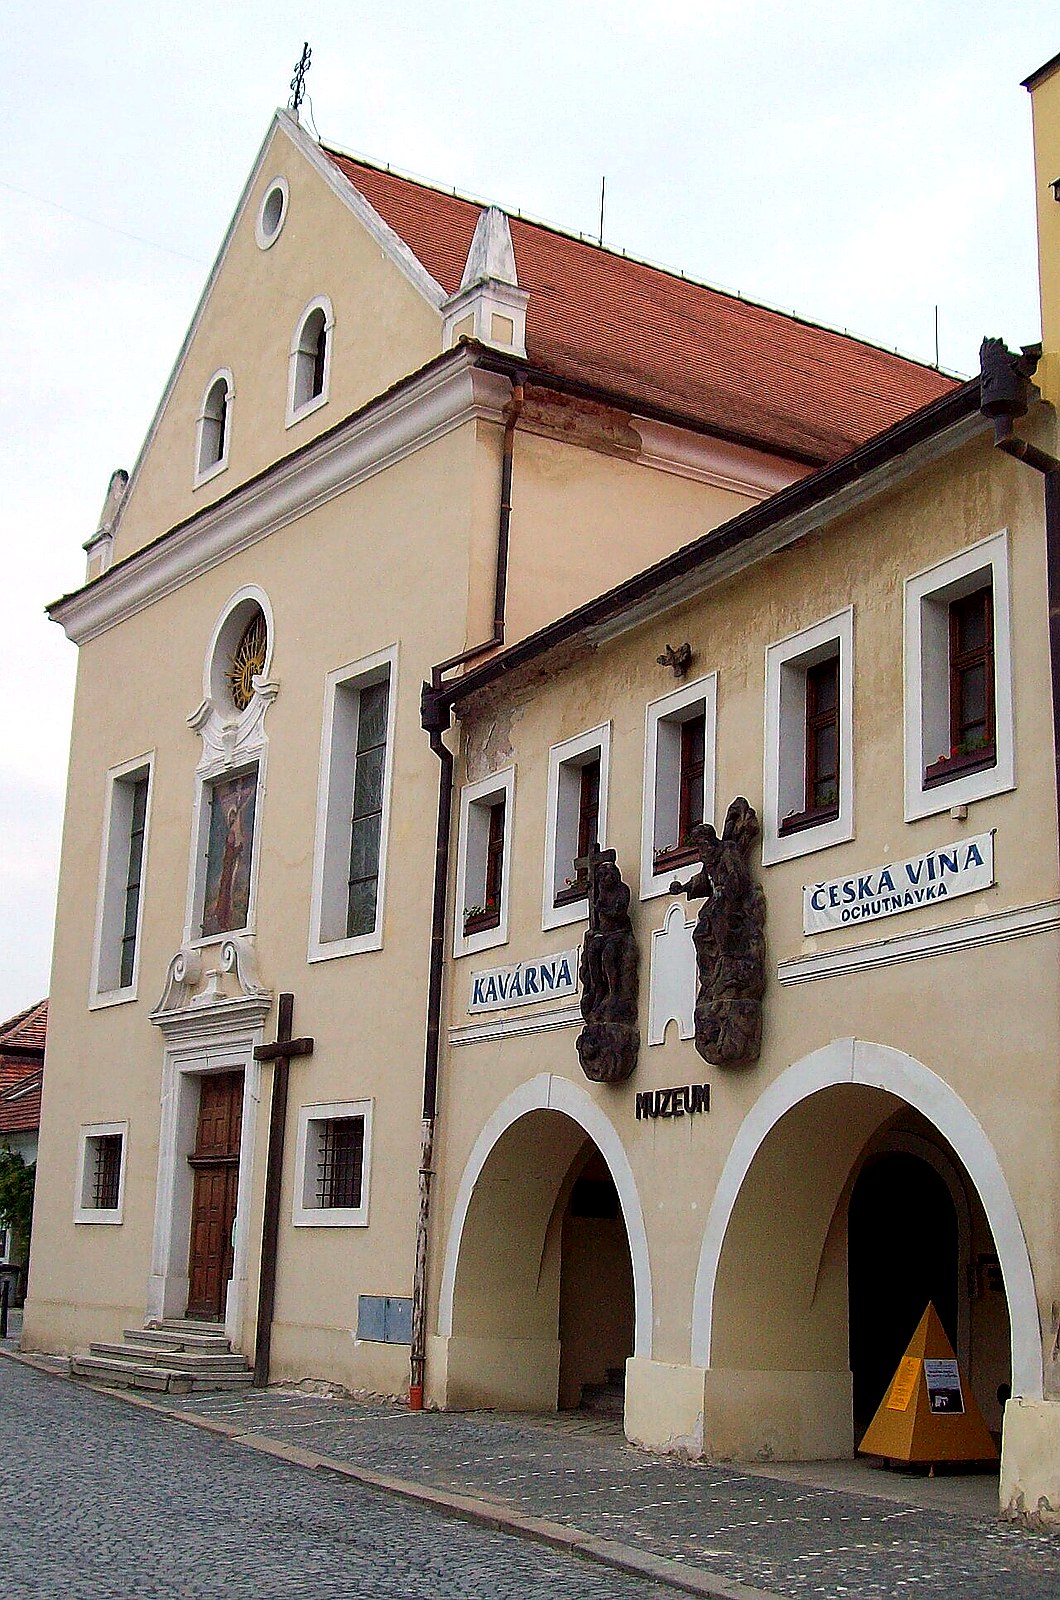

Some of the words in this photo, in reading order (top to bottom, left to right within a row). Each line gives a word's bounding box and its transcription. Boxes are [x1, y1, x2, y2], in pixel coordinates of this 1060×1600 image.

[810, 864, 896, 911] ČESKÁ
[905, 843, 984, 885] VÍNA
[841, 882, 948, 922] OCHUTNÁVKA
[472, 959, 572, 1005] KAVÁRNA
[635, 1083, 711, 1120] MUZEUM
